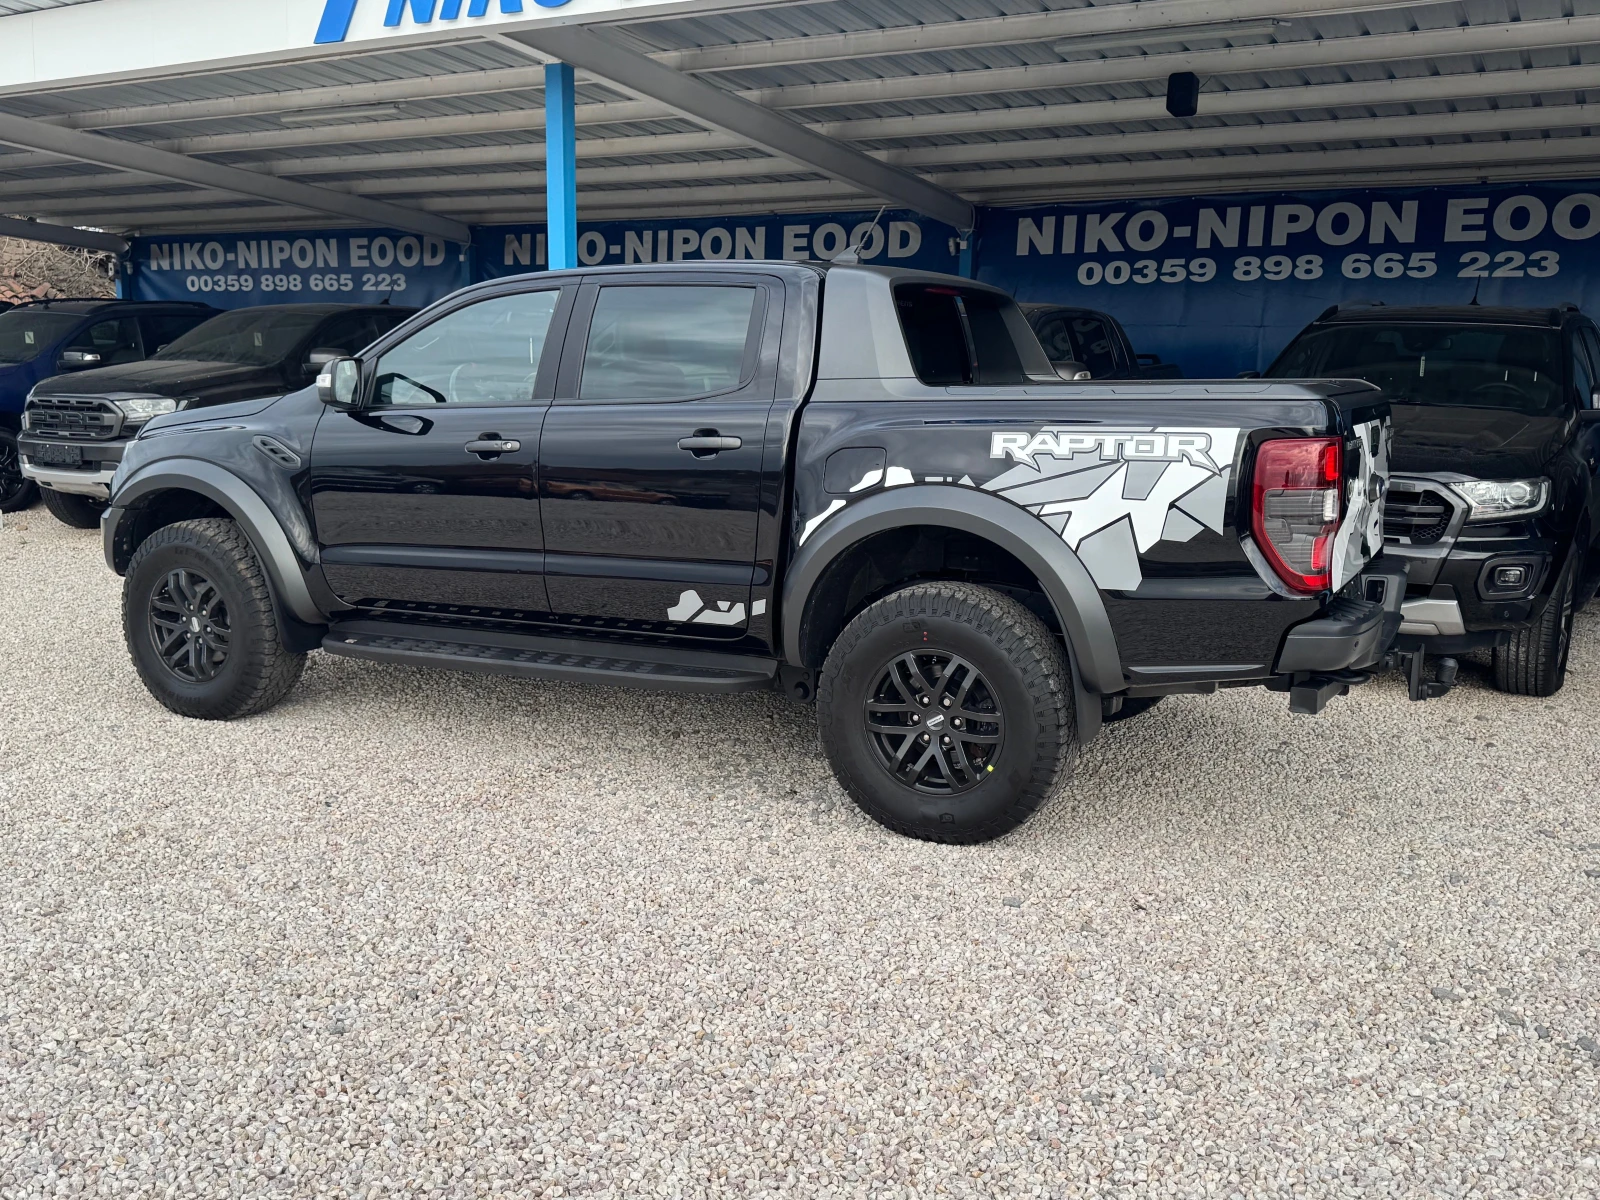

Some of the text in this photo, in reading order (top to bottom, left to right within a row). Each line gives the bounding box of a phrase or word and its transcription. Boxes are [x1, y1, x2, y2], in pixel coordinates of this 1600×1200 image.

[503, 221, 923, 266] NIO-NIPON EOOD
[1015, 200, 1419, 256] NIKO-NIPON
[150, 236, 446, 271] NIKO-NIPON EOOD
[1077, 250, 1560, 285] 00359 898 665 223
[186, 272, 406, 292] 00359 898 665 223
[989, 430, 1222, 477] RAPTOR
